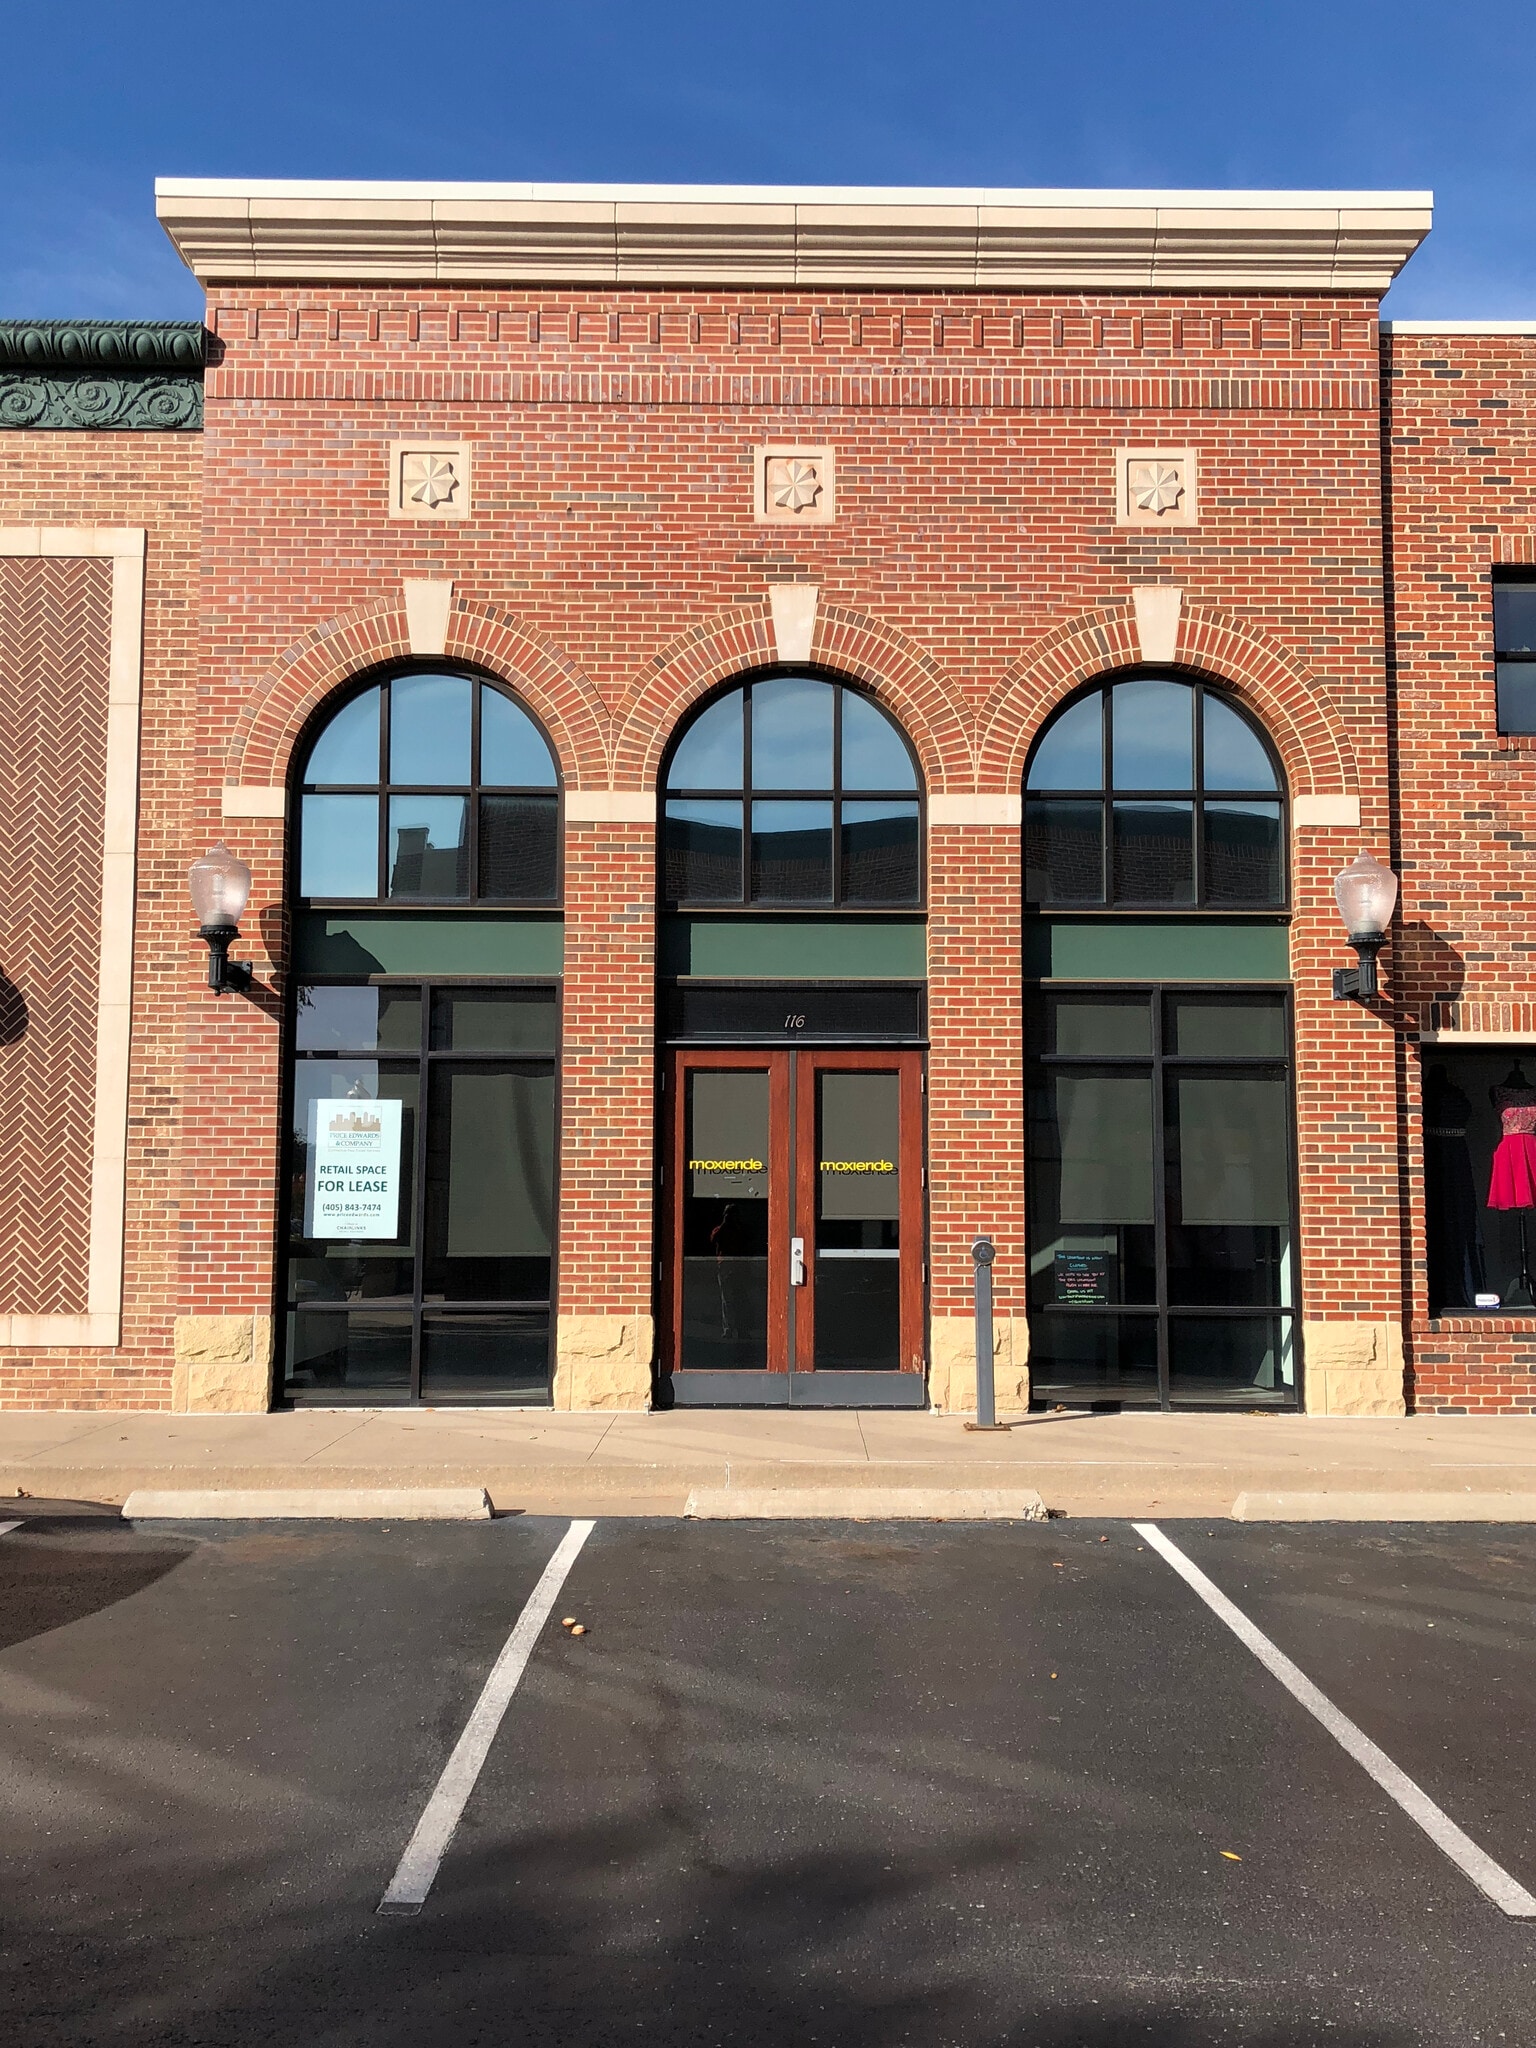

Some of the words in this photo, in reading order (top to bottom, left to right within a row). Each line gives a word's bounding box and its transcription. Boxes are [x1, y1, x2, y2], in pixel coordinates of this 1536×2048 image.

[784, 1014, 806, 1028] 116
[319, 1165, 354, 1175] RETAIL
[356, 1165, 387, 1175] SPACE
[317, 1180, 344, 1192] FOR
[349, 1180, 388, 1192] LEASE
[322, 1203, 343, 1212] (405)
[344, 1203, 381, 1212] 843-7474
